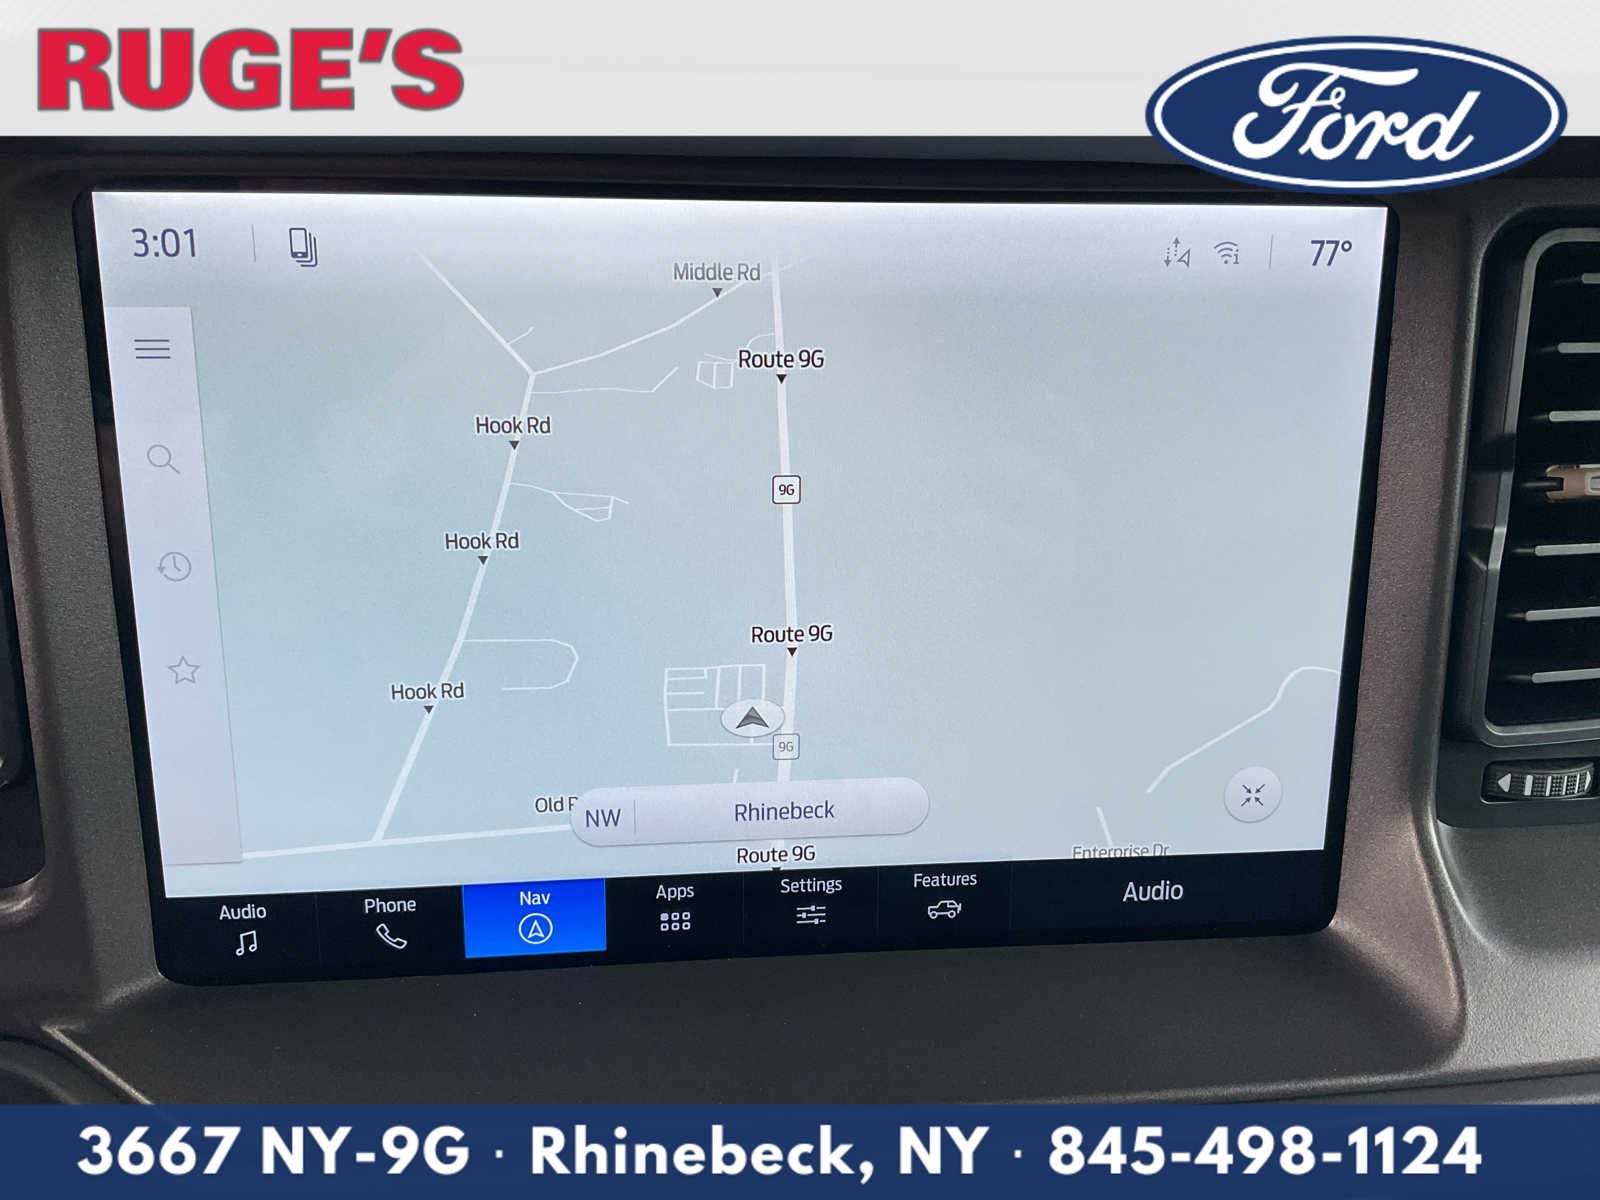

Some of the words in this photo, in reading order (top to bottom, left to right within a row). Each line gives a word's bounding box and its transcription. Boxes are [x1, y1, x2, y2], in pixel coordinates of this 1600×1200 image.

[131, 228, 197, 259] 3:01
[672, 262, 734, 281] Middle
[737, 262, 761, 281] Rd
[738, 349, 795, 368] Route
[798, 349, 825, 368] 9G
[475, 416, 523, 434] Hook
[527, 416, 551, 434] Rd
[778, 483, 795, 496] 9G
[445, 532, 492, 550] Hook
[495, 532, 519, 550] Rd
[751, 626, 804, 643] Route
[807, 625, 833, 642] 9G
[391, 683, 437, 701] Hook
[440, 682, 464, 700] Rd
[778, 741, 794, 752] 9G
[535, 796, 564, 814] Old
[734, 800, 835, 821] Rhinebeck
[585, 808, 621, 828] NW
[737, 847, 788, 864] Route
[792, 845, 816, 861] 9G
[1072, 844, 1150, 859] Enterprise
[1152, 843, 1170, 857] Dr
[780, 876, 843, 895] Settings
[913, 871, 977, 888] Features
[520, 890, 550, 906] Nav
[656, 883, 694, 901] Apps
[1122, 880, 1184, 902] Audio
[219, 903, 267, 920] Audio
[364, 896, 416, 913] Phone
